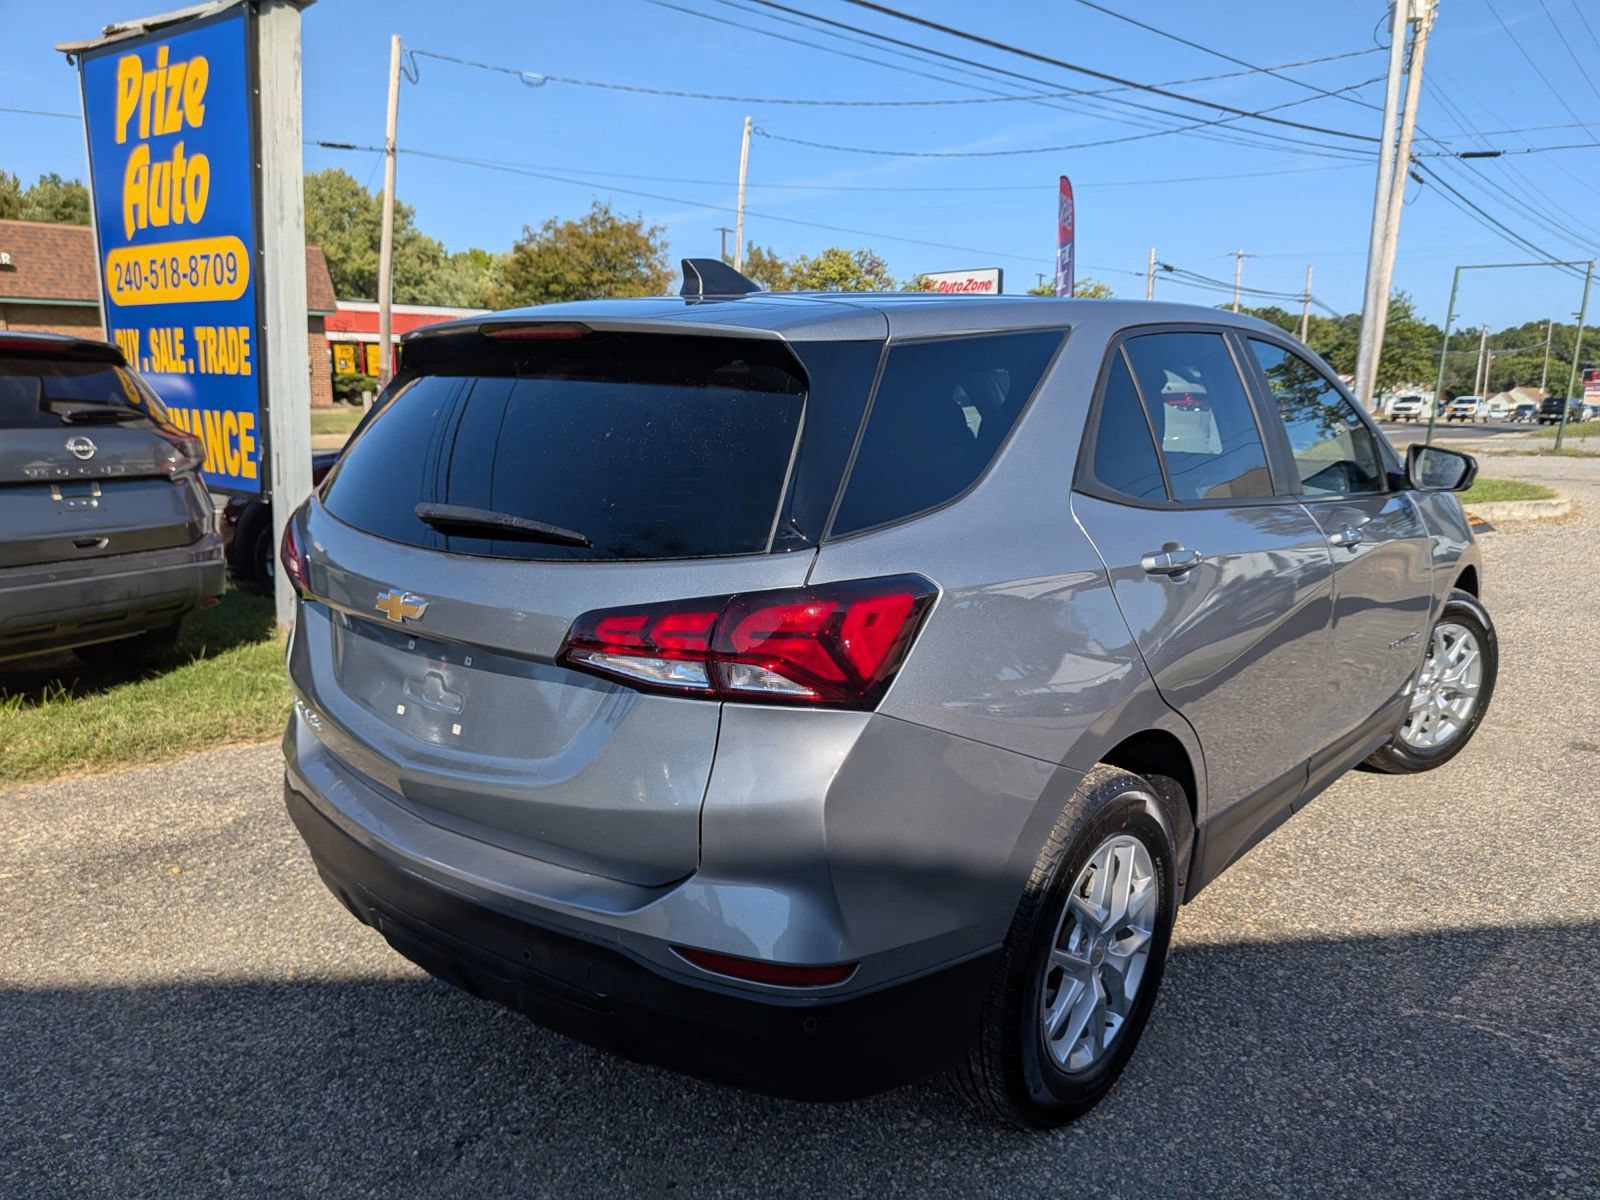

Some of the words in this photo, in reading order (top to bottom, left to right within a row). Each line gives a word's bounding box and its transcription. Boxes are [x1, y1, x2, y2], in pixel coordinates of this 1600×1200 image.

[116, 45, 209, 144] Prize
[123, 140, 210, 241] Auto
[114, 252, 237, 292] 240-518-8709
[195, 327, 251, 375] TRADE
